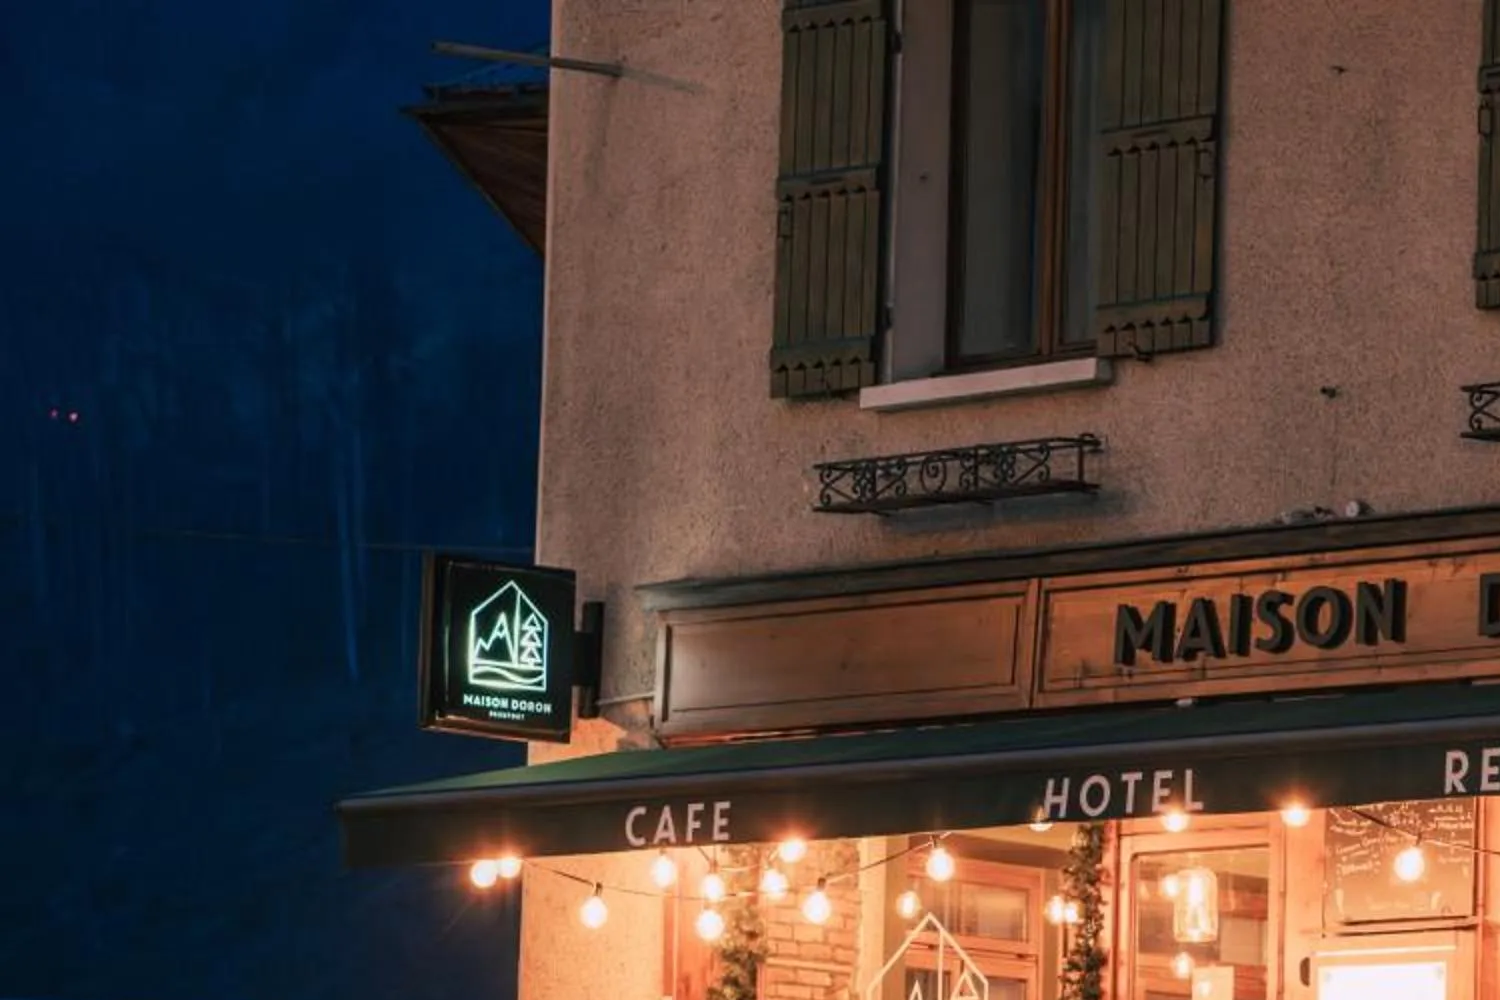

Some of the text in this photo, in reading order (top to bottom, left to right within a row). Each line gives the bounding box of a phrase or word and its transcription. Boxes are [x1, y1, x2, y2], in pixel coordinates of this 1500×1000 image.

[1115, 578, 1406, 665] MAISON
[463, 694, 552, 715] MAISON DORON
[1043, 768, 1204, 818] HOTEL
[625, 801, 731, 847] CAFE
